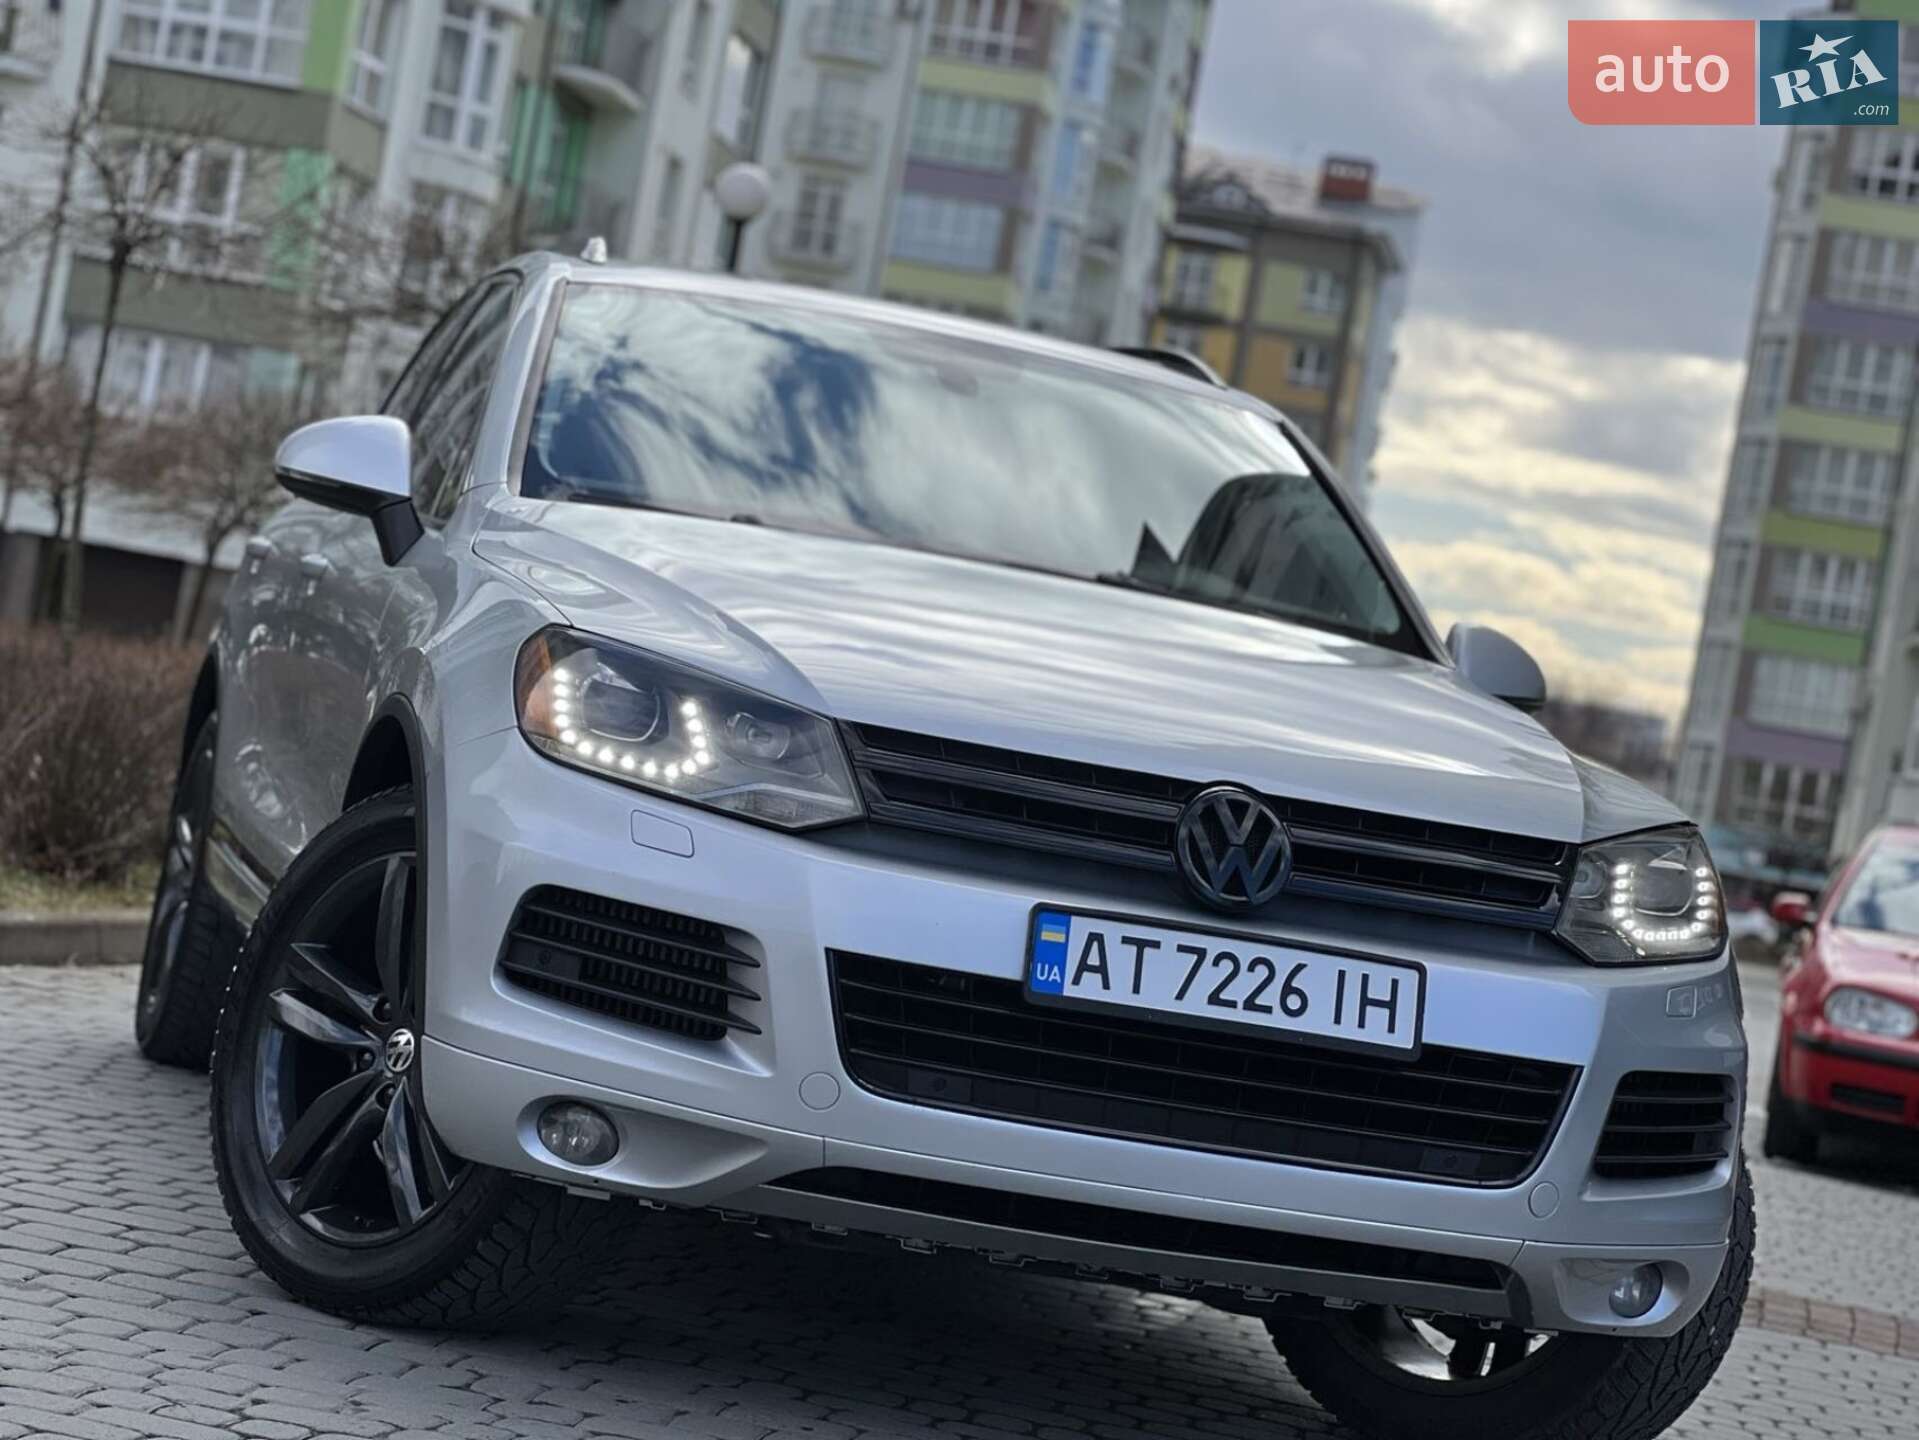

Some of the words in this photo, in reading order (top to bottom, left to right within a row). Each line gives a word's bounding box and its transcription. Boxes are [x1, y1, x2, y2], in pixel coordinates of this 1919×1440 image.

[1036, 963, 1062, 984] UA
[1070, 931, 1162, 996] AT
[1173, 943, 1309, 1019] 7226
[1332, 968, 1400, 1034] IH
